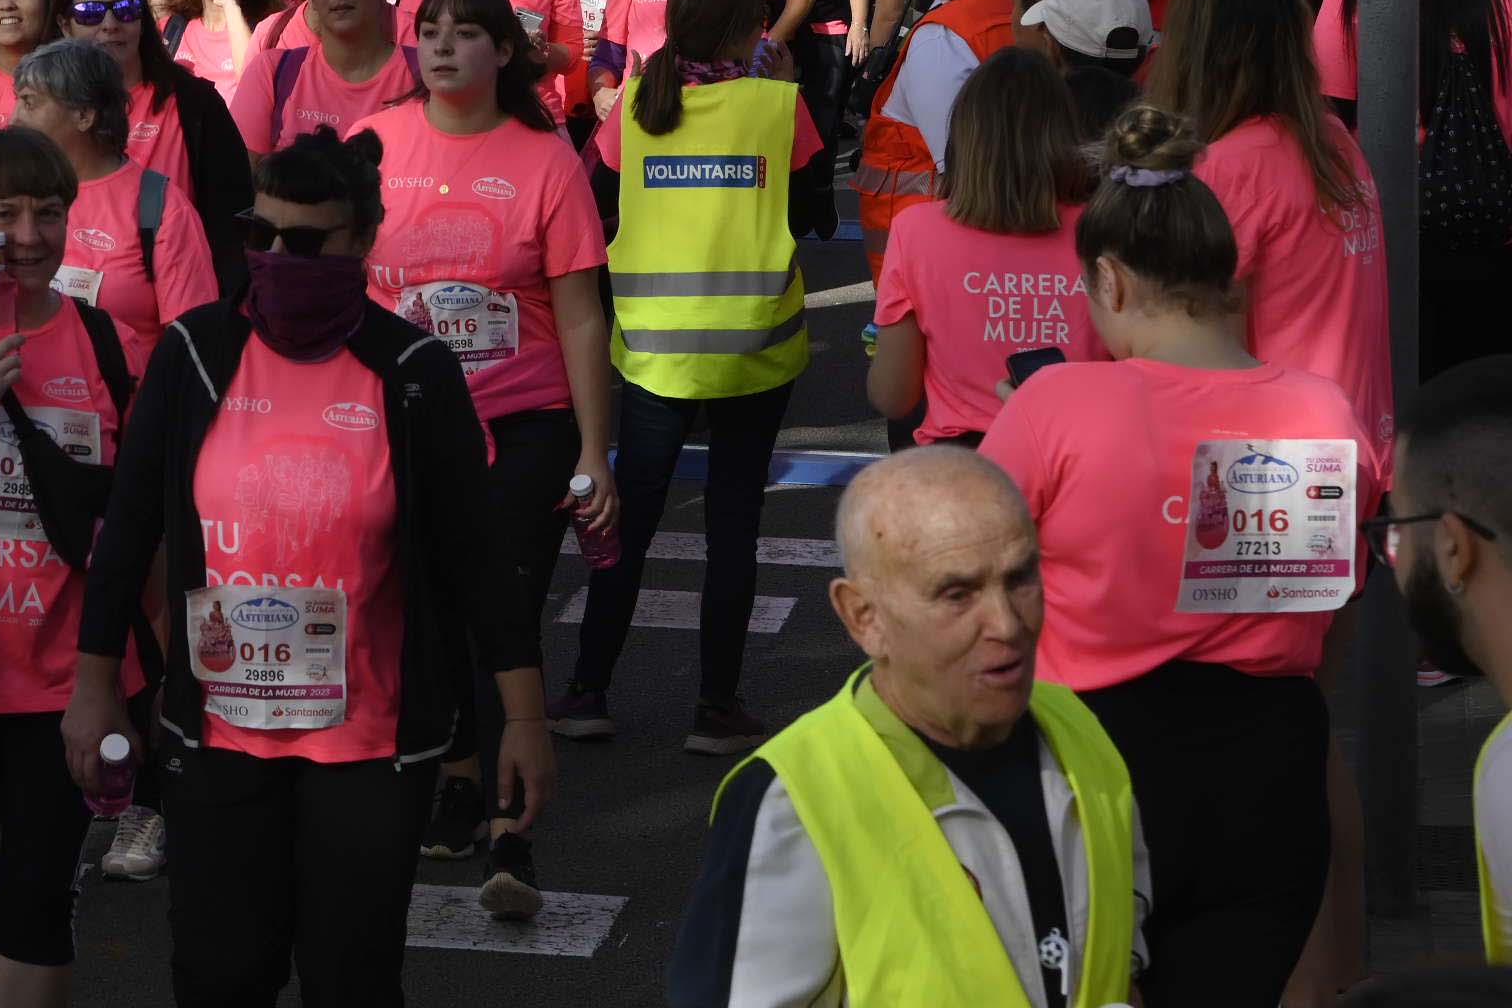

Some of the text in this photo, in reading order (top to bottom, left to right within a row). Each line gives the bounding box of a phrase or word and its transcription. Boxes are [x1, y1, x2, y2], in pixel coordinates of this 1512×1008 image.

[646, 164, 753, 179] VOLUNTARIS
[389, 176, 434, 189] OYSHO
[372, 265, 405, 289] TU
[963, 271, 1088, 296] CARRERA
[989, 296, 1065, 319] DE LA
[439, 319, 477, 335] 016
[983, 320, 1070, 344] MUJER
[1306, 463, 1342, 473] SUMA
[1230, 469, 1293, 484] ASTURIANA
[1233, 508, 1289, 533] 016
[200, 520, 240, 554] TU
[1236, 541, 1281, 556] 27213
[1200, 564, 1335, 574] CARRERA DE LA MUJER 2023
[1193, 587, 1237, 601] OYSHO
[1282, 587, 1339, 598] Santander
[238, 608, 295, 623] ASTURIANA
[305, 604, 336, 614] SUMA
[240, 643, 291, 662] 016
[245, 668, 285, 682] 29896
[208, 685, 248, 696] CARRERA
[249, 688, 260, 696] DE
[276, 689, 307, 697] MUJER
[285, 707, 334, 717] Santander
